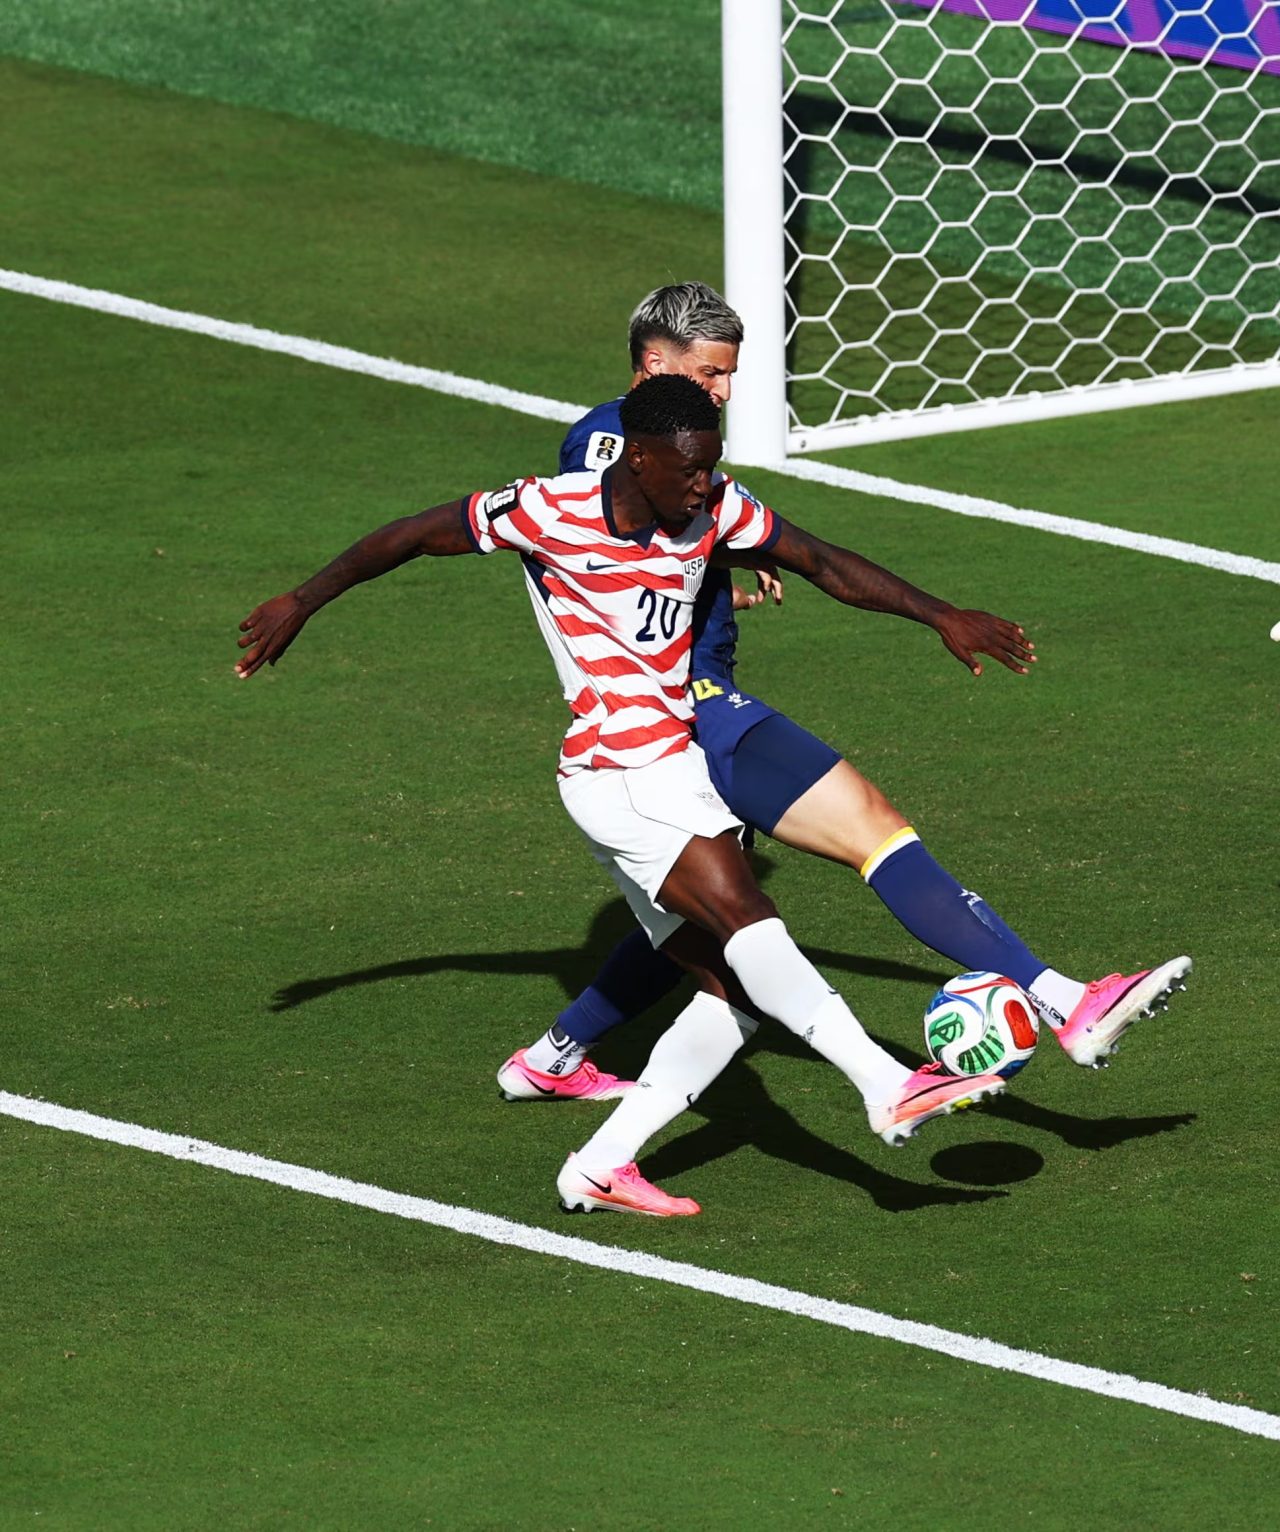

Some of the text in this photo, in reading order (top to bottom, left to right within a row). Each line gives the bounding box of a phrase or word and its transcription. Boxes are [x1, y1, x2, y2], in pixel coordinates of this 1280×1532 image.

[684, 557, 703, 576] USA
[635, 587, 681, 642] 20
[692, 678, 725, 701] 4
